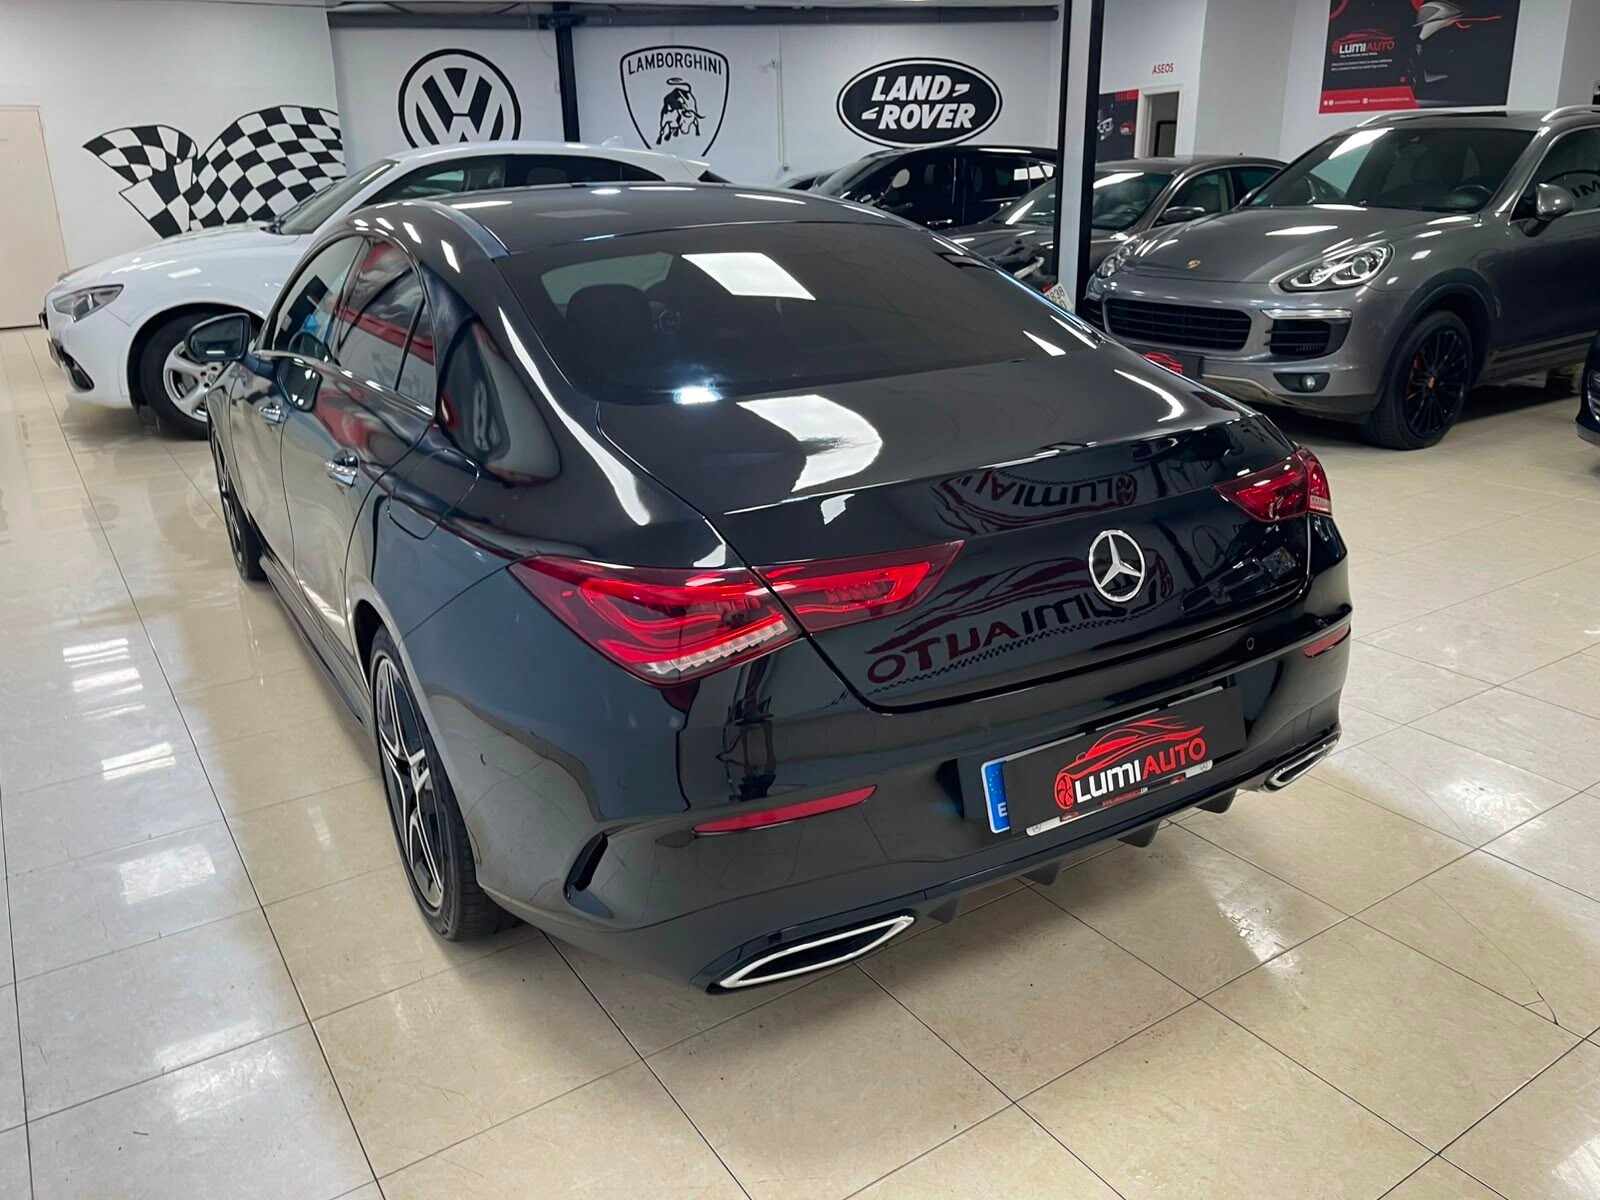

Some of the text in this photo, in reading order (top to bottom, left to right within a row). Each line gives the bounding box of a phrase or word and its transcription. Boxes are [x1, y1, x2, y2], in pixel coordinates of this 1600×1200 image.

[627, 52, 722, 75] LAMBORGHINI
[1151, 62, 1174, 75] ASEOS
[871, 75, 952, 101] LAND
[878, 103, 976, 130] ROVER
[1074, 737, 1207, 804] LUMIAUTO
[997, 802, 1008, 818] E
